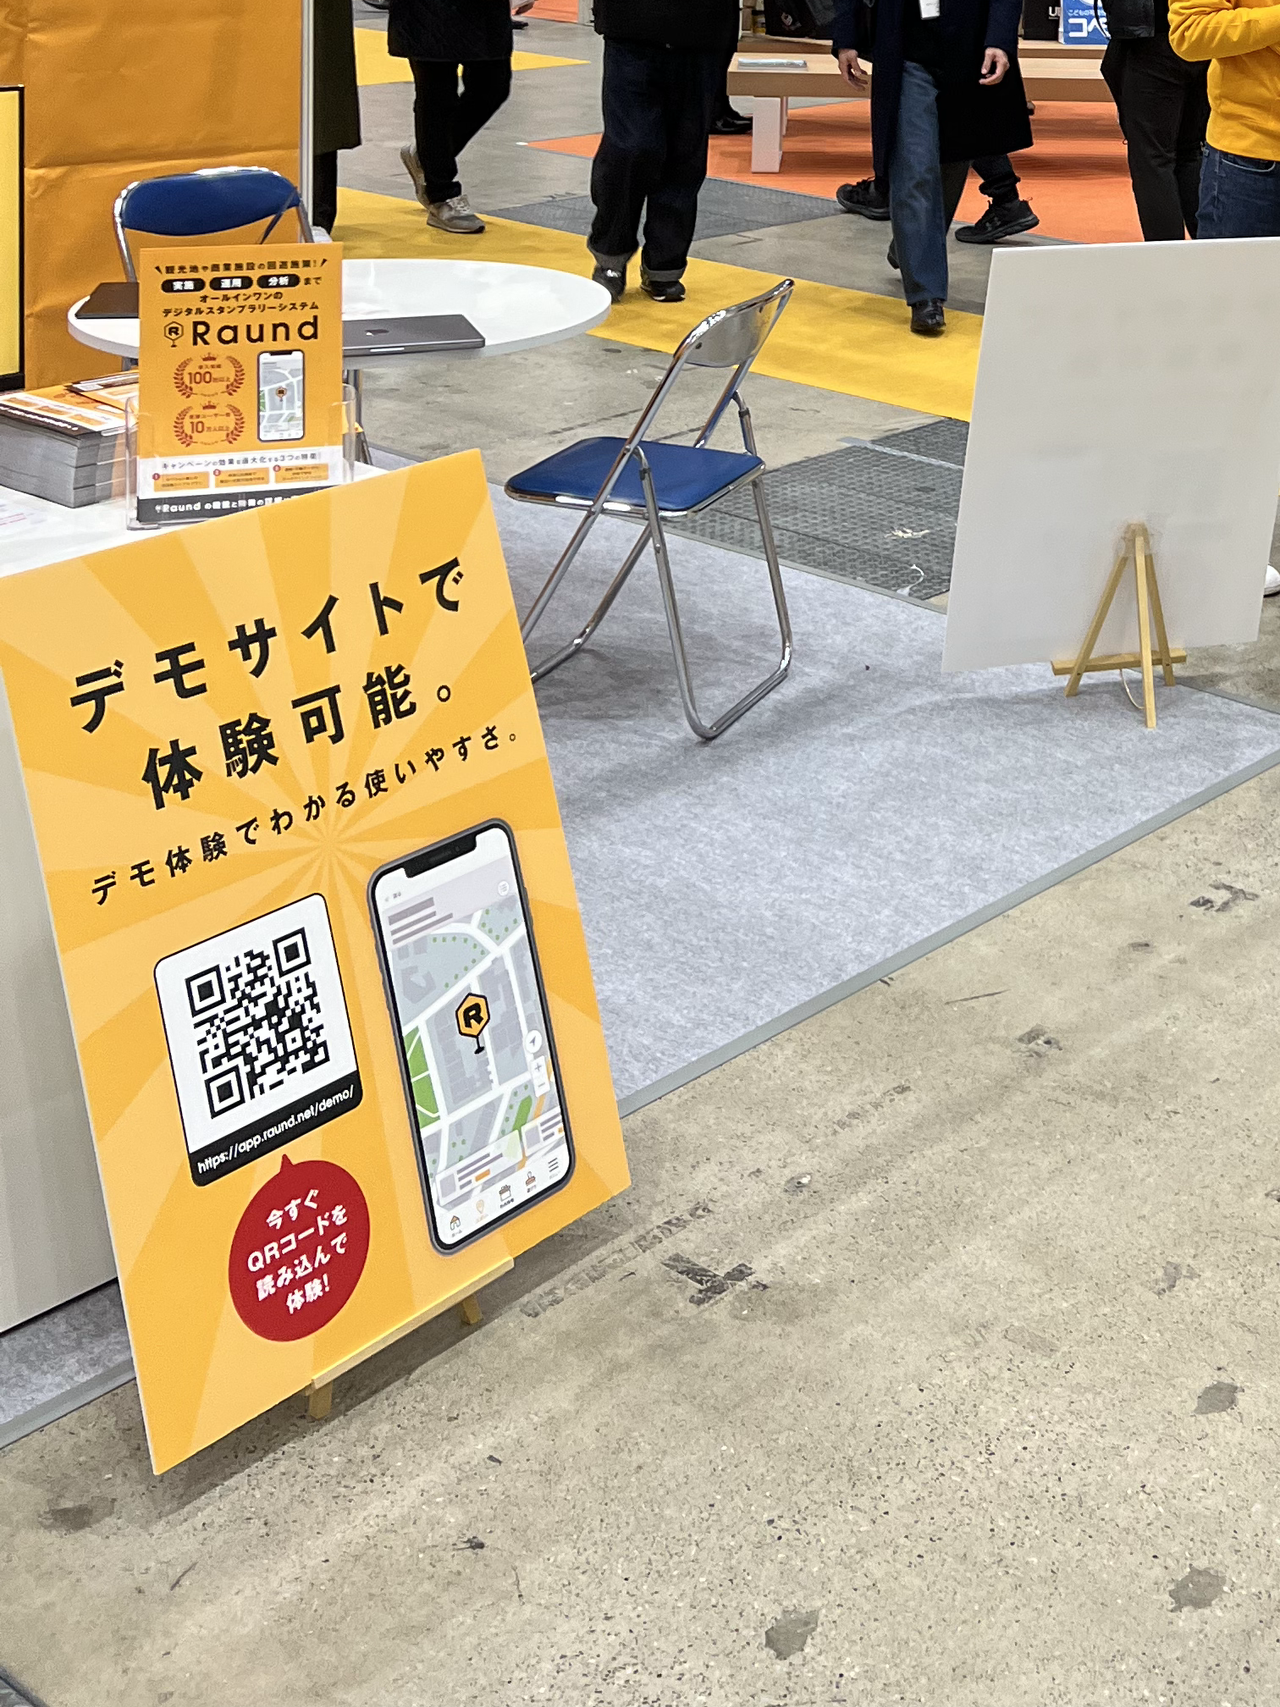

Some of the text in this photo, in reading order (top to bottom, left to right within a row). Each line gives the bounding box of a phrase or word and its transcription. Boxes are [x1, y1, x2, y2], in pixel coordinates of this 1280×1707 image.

[200, 291, 284, 303] オールインワンの
[268, 276, 289, 286] 分析
[304, 277, 322, 285] まで
[162, 302, 319, 317] デジタルスタンプラリーシステム
[192, 315, 319, 346] Raund
[162, 501, 201, 514] Raund
[70, 557, 466, 734] デモサイトで
[141, 664, 452, 811] 体験可能。
[91, 726, 517, 906] デモ体験でわかる使いやすさ。
[197, 1084, 354, 1174] https://app.raund.net/demo/
[266, 1189, 319, 1230] 今すぐ
[247, 1205, 348, 1272] QRコードを
[256, 1232, 348, 1301] 読み込んで
[286, 1273, 330, 1314] 体験!
